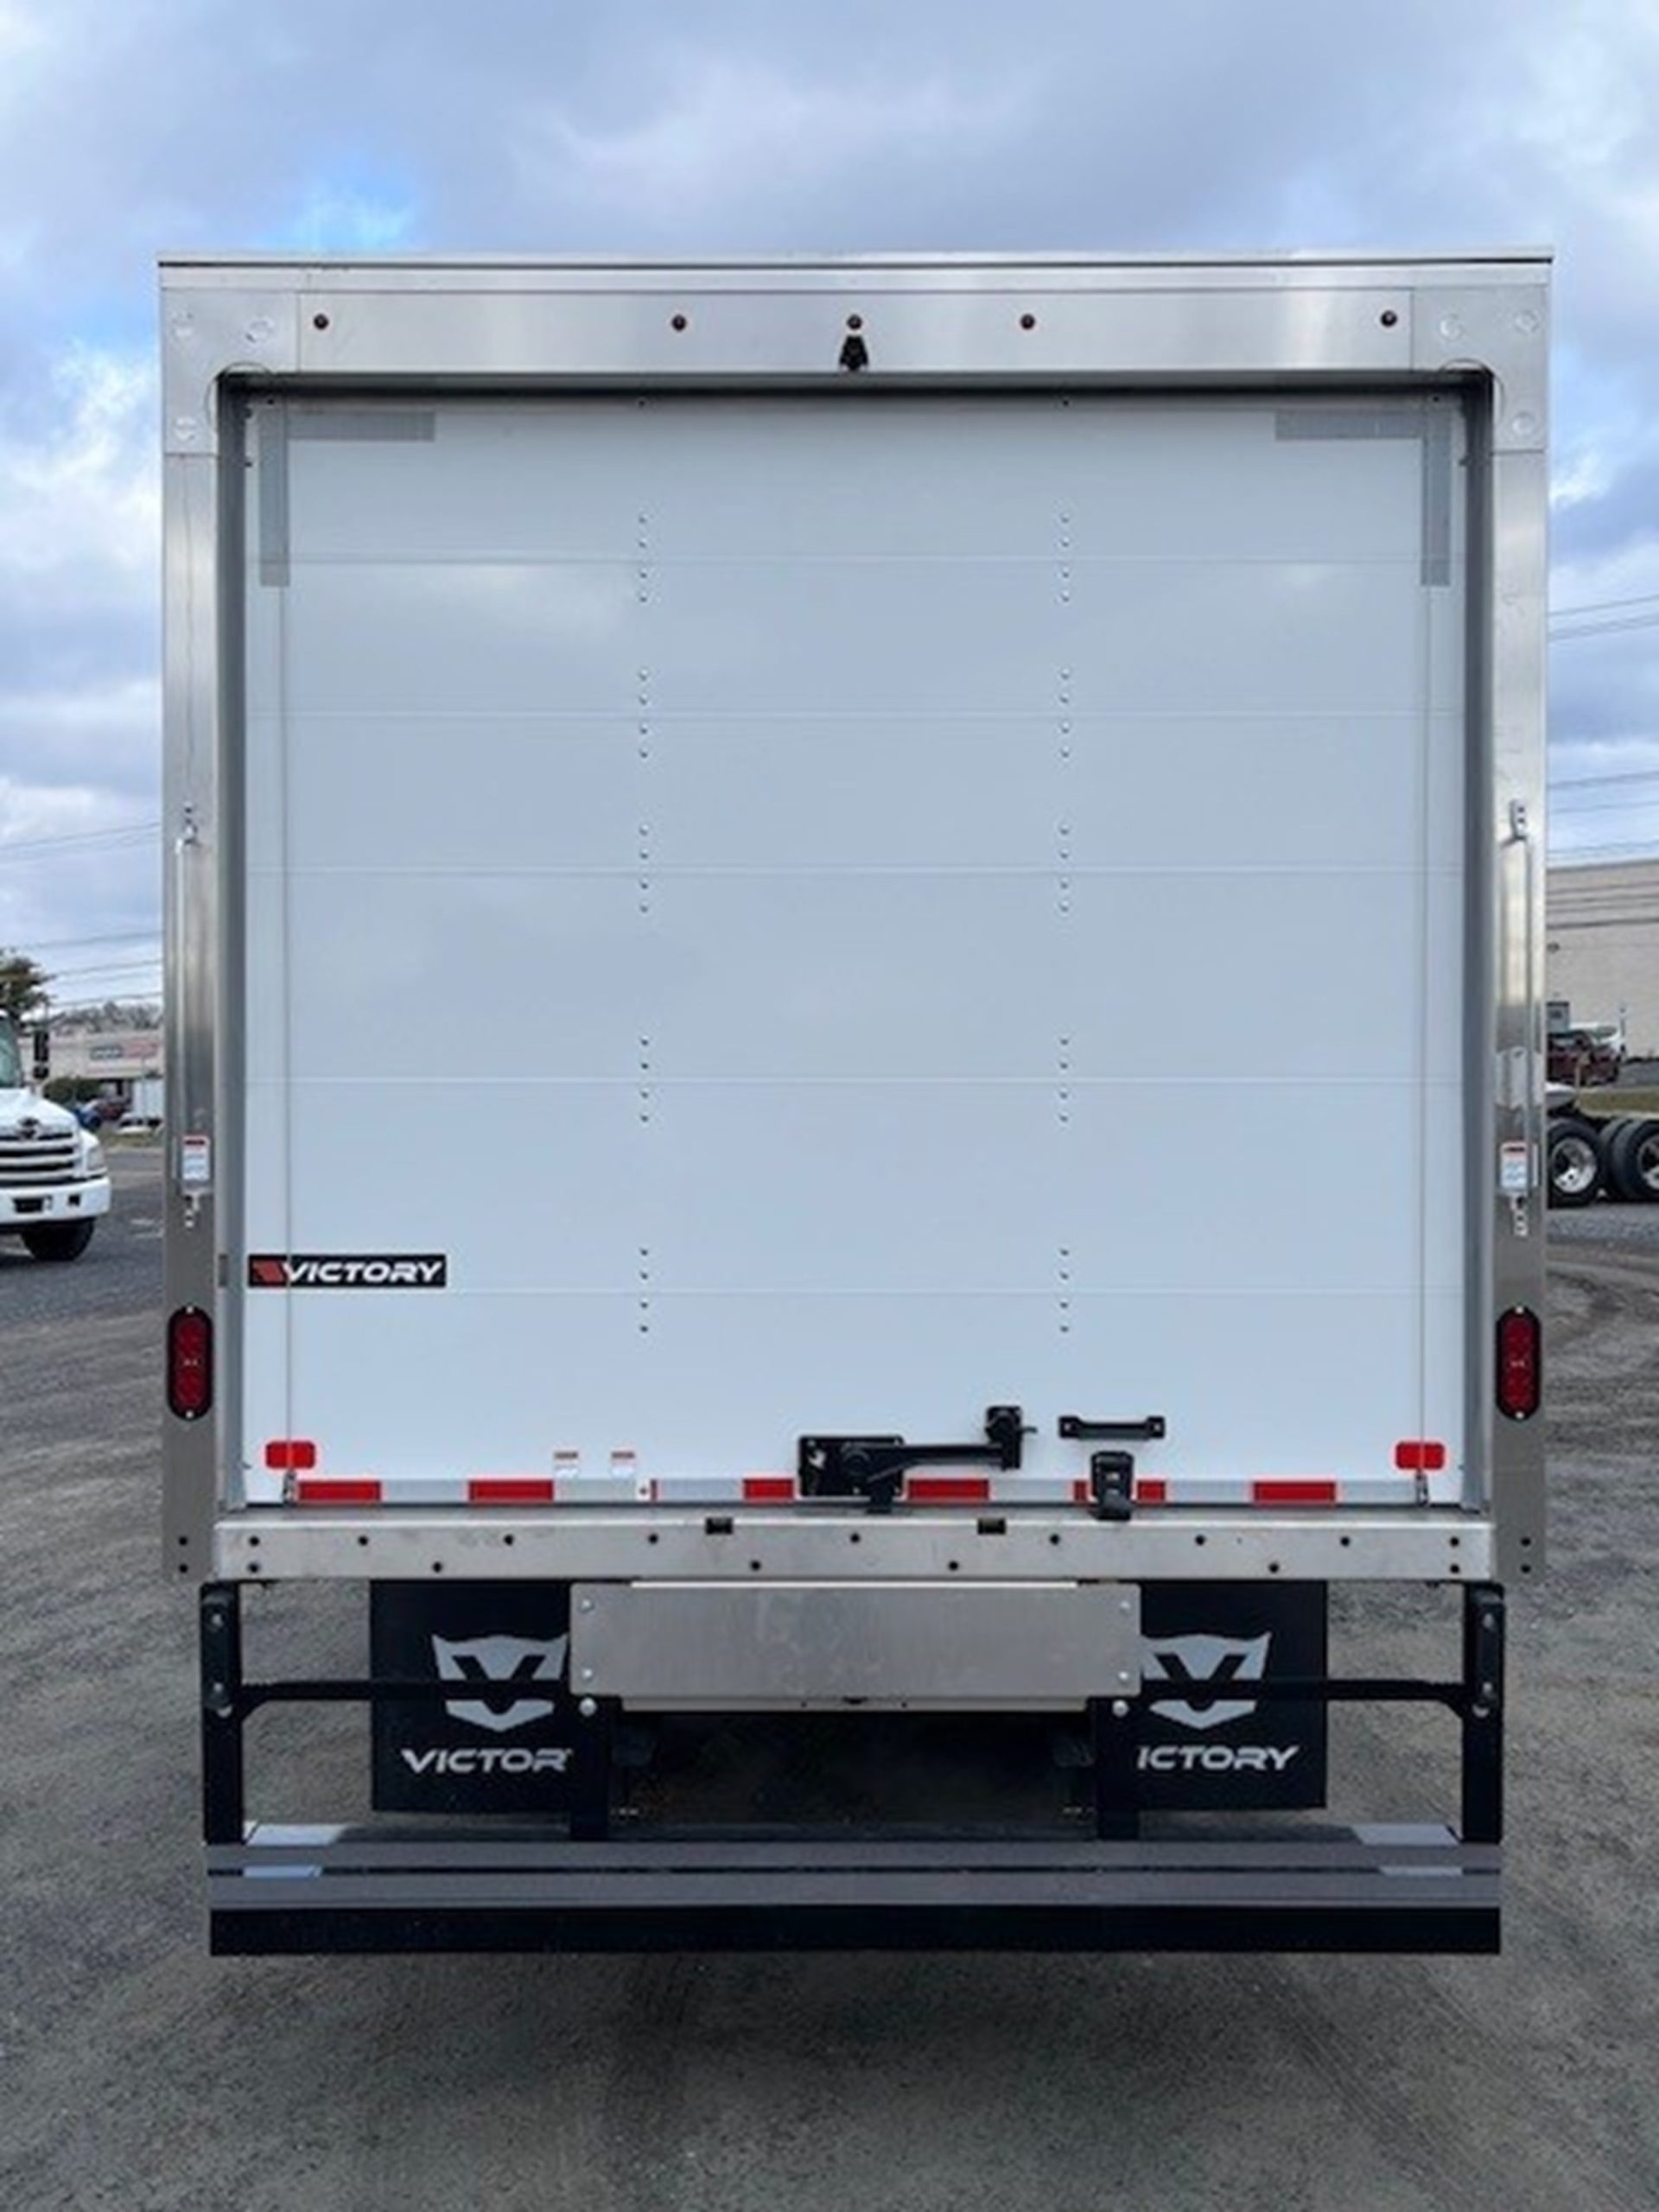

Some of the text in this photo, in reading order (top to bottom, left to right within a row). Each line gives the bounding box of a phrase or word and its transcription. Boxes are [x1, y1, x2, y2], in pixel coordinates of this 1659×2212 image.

[283, 1262, 442, 1282] VICTORY
[400, 1748, 573, 1772] VICTOR
[1137, 1745, 1299, 1770] ICTORY
